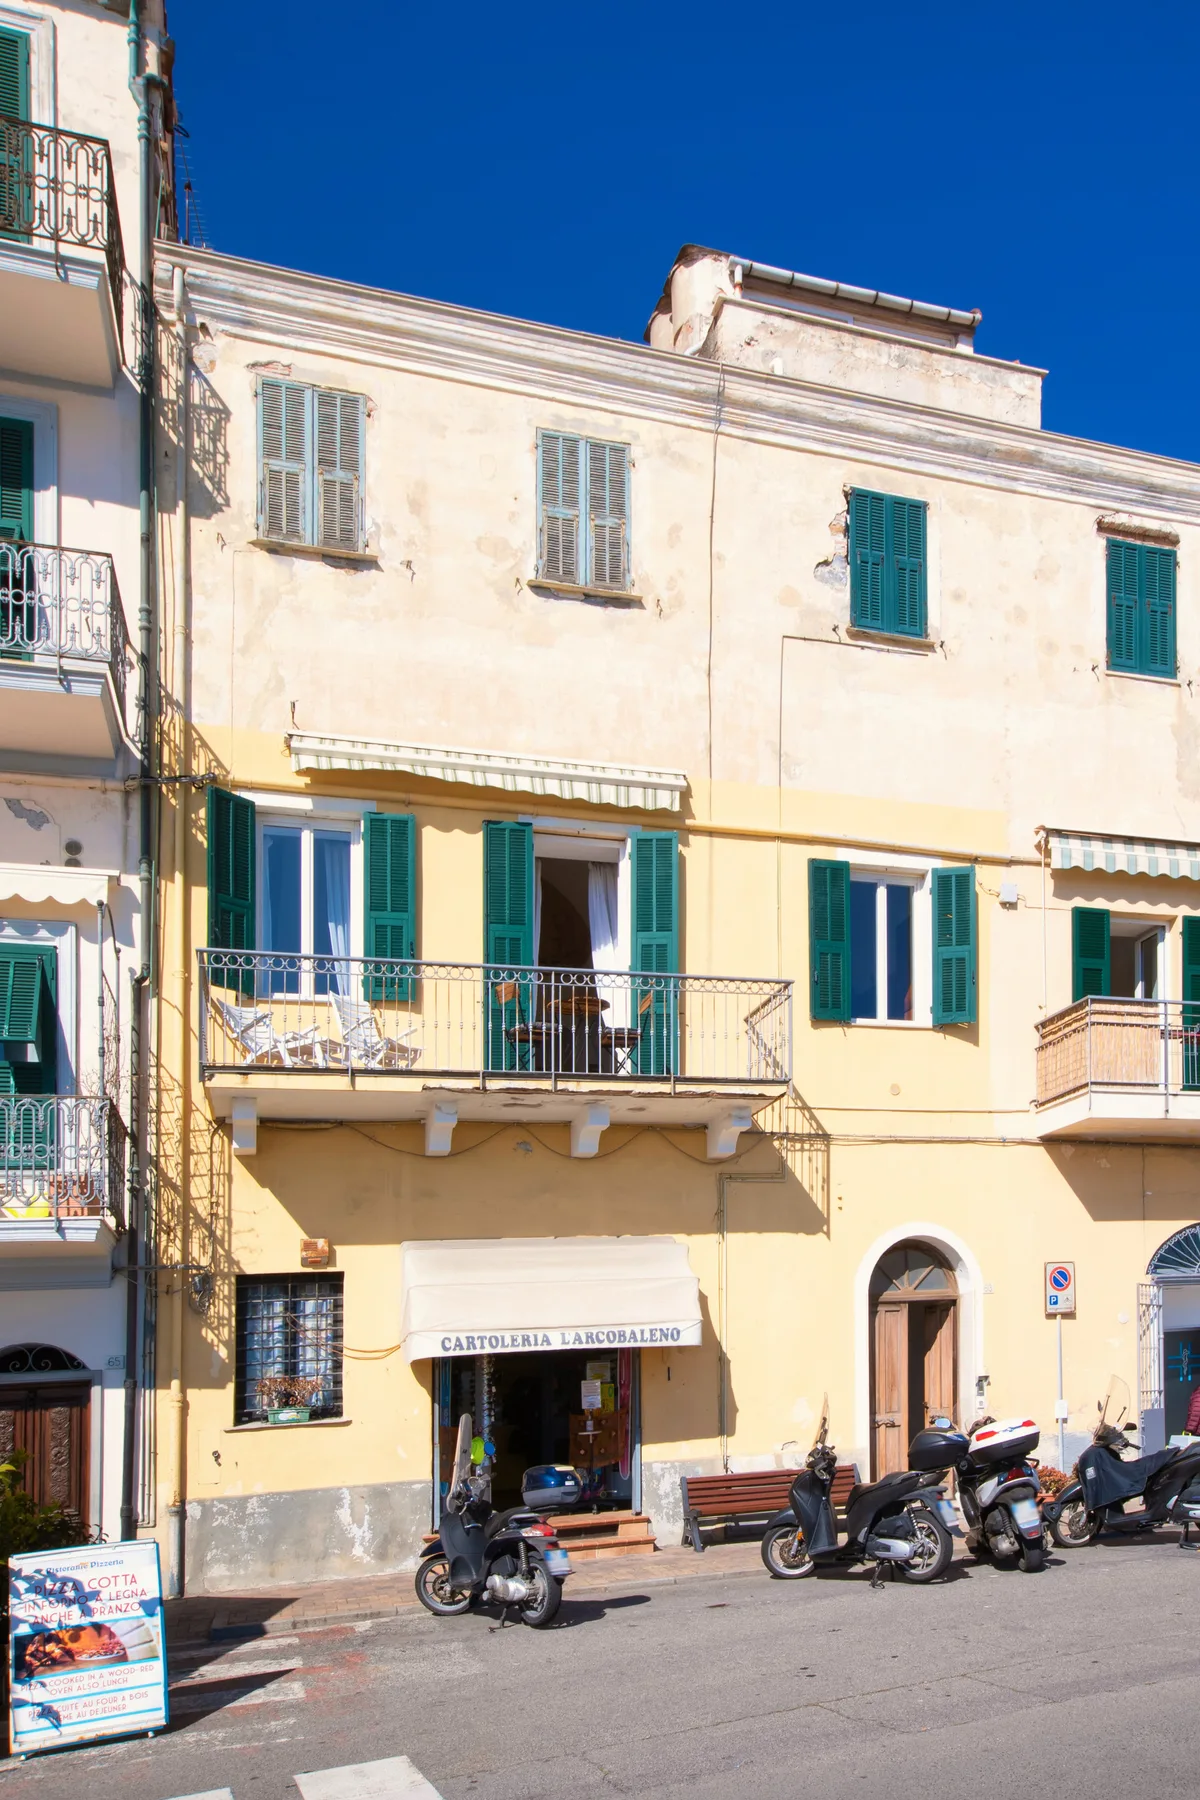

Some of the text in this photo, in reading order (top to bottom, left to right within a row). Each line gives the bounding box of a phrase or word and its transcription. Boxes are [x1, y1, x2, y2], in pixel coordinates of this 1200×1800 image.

[441, 1327, 681, 1352] CARTOLERIA L'ARCOBALENO
[108, 1357, 121, 1366] 65
[46, 1559, 124, 1574] Ristorante Pizzeria
[34, 1573, 138, 1597] PIZZA COTTA
[24, 1588, 148, 1613] IN FORNO A LEGNA
[32, 1601, 142, 1626] ANCHE A PRANZO
[49, 1675, 85, 1687] COOKED
[88, 1673, 96, 1681] IN
[50, 1677, 128, 1696] OVEN ALSO LUNCH
[57, 1702, 80, 1713] CUITE
[82, 1700, 94, 1709] AU
[96, 1695, 118, 1706] FOUR
[129, 1690, 149, 1701] BOIS
[76, 1709, 87, 1719] AU
